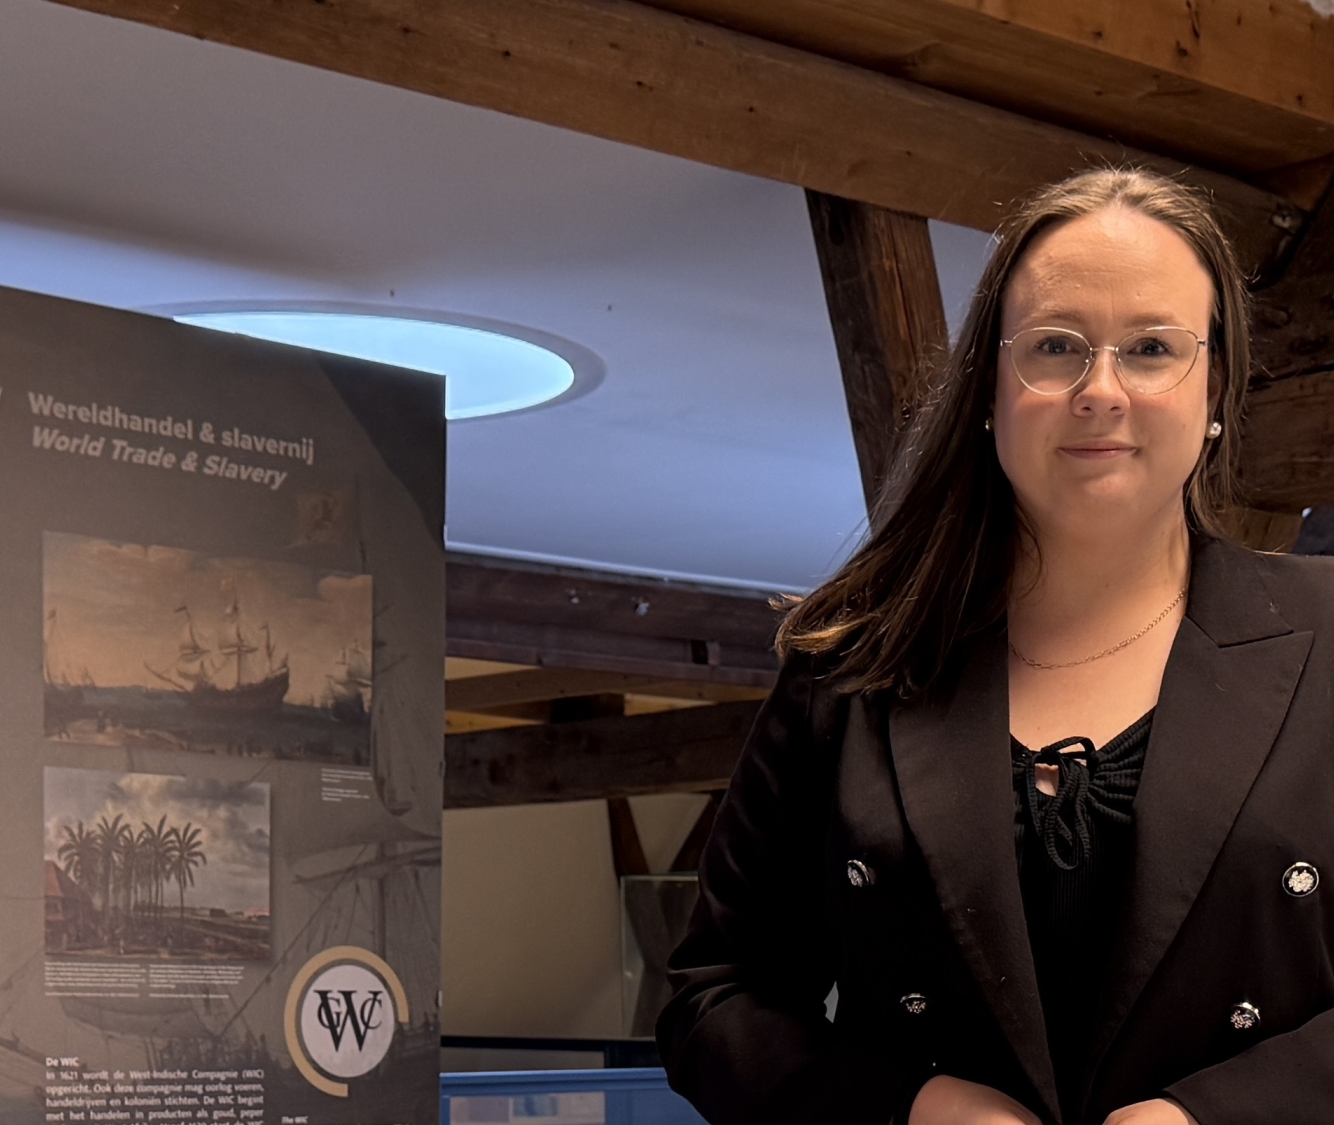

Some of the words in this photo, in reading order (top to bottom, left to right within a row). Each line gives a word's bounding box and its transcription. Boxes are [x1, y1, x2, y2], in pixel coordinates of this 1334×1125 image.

[28, 391, 193, 441] Wereldhandel
[199, 422, 215, 445] &
[221, 427, 314, 466] slavernij
[33, 425, 106, 457] World
[112, 438, 177, 469] Trade
[180, 450, 198, 473] &
[202, 454, 288, 491] Slavery
[45, 1057, 59, 1067] De
[59, 1056, 79, 1067] WIC
[45, 1070, 56, 1080] In
[82, 1070, 109, 1080] wordt
[113, 1070, 125, 1080] de
[129, 1069, 188, 1080] West-Indische
[191, 1069, 239, 1082] Compagnie
[242, 1069, 265, 1079] (WIC)
